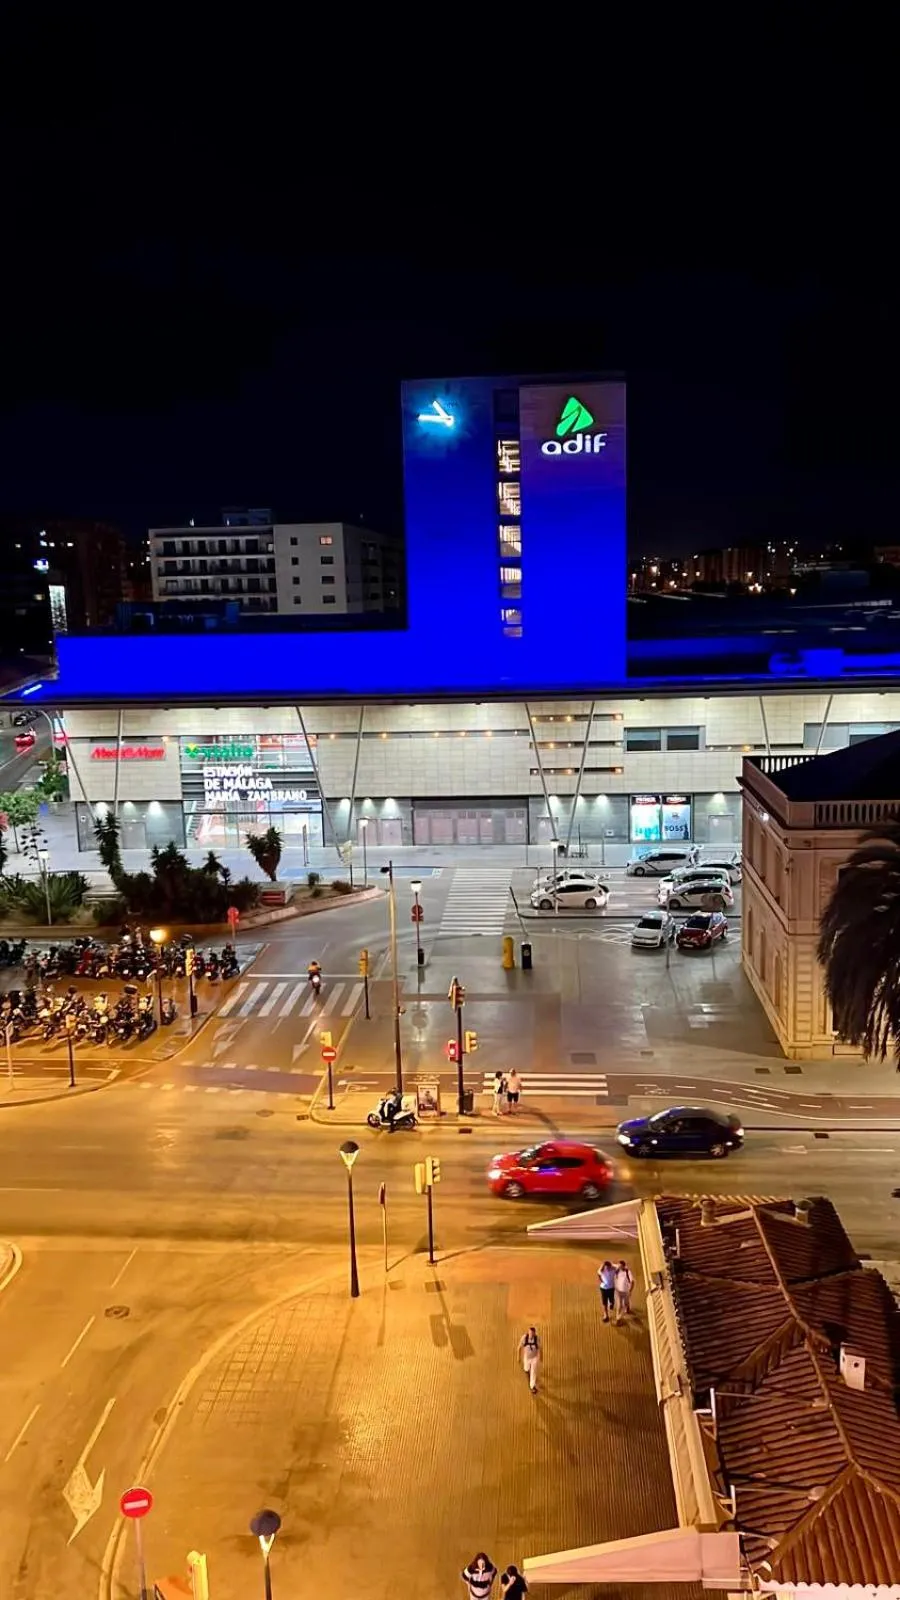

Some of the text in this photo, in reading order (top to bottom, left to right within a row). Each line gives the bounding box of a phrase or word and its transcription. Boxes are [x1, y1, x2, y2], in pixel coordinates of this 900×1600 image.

[541, 433, 608, 455] adif
[204, 775, 273, 790] DE MÁLAGA
[205, 788, 307, 801] MARÍA ZAMBRANO
